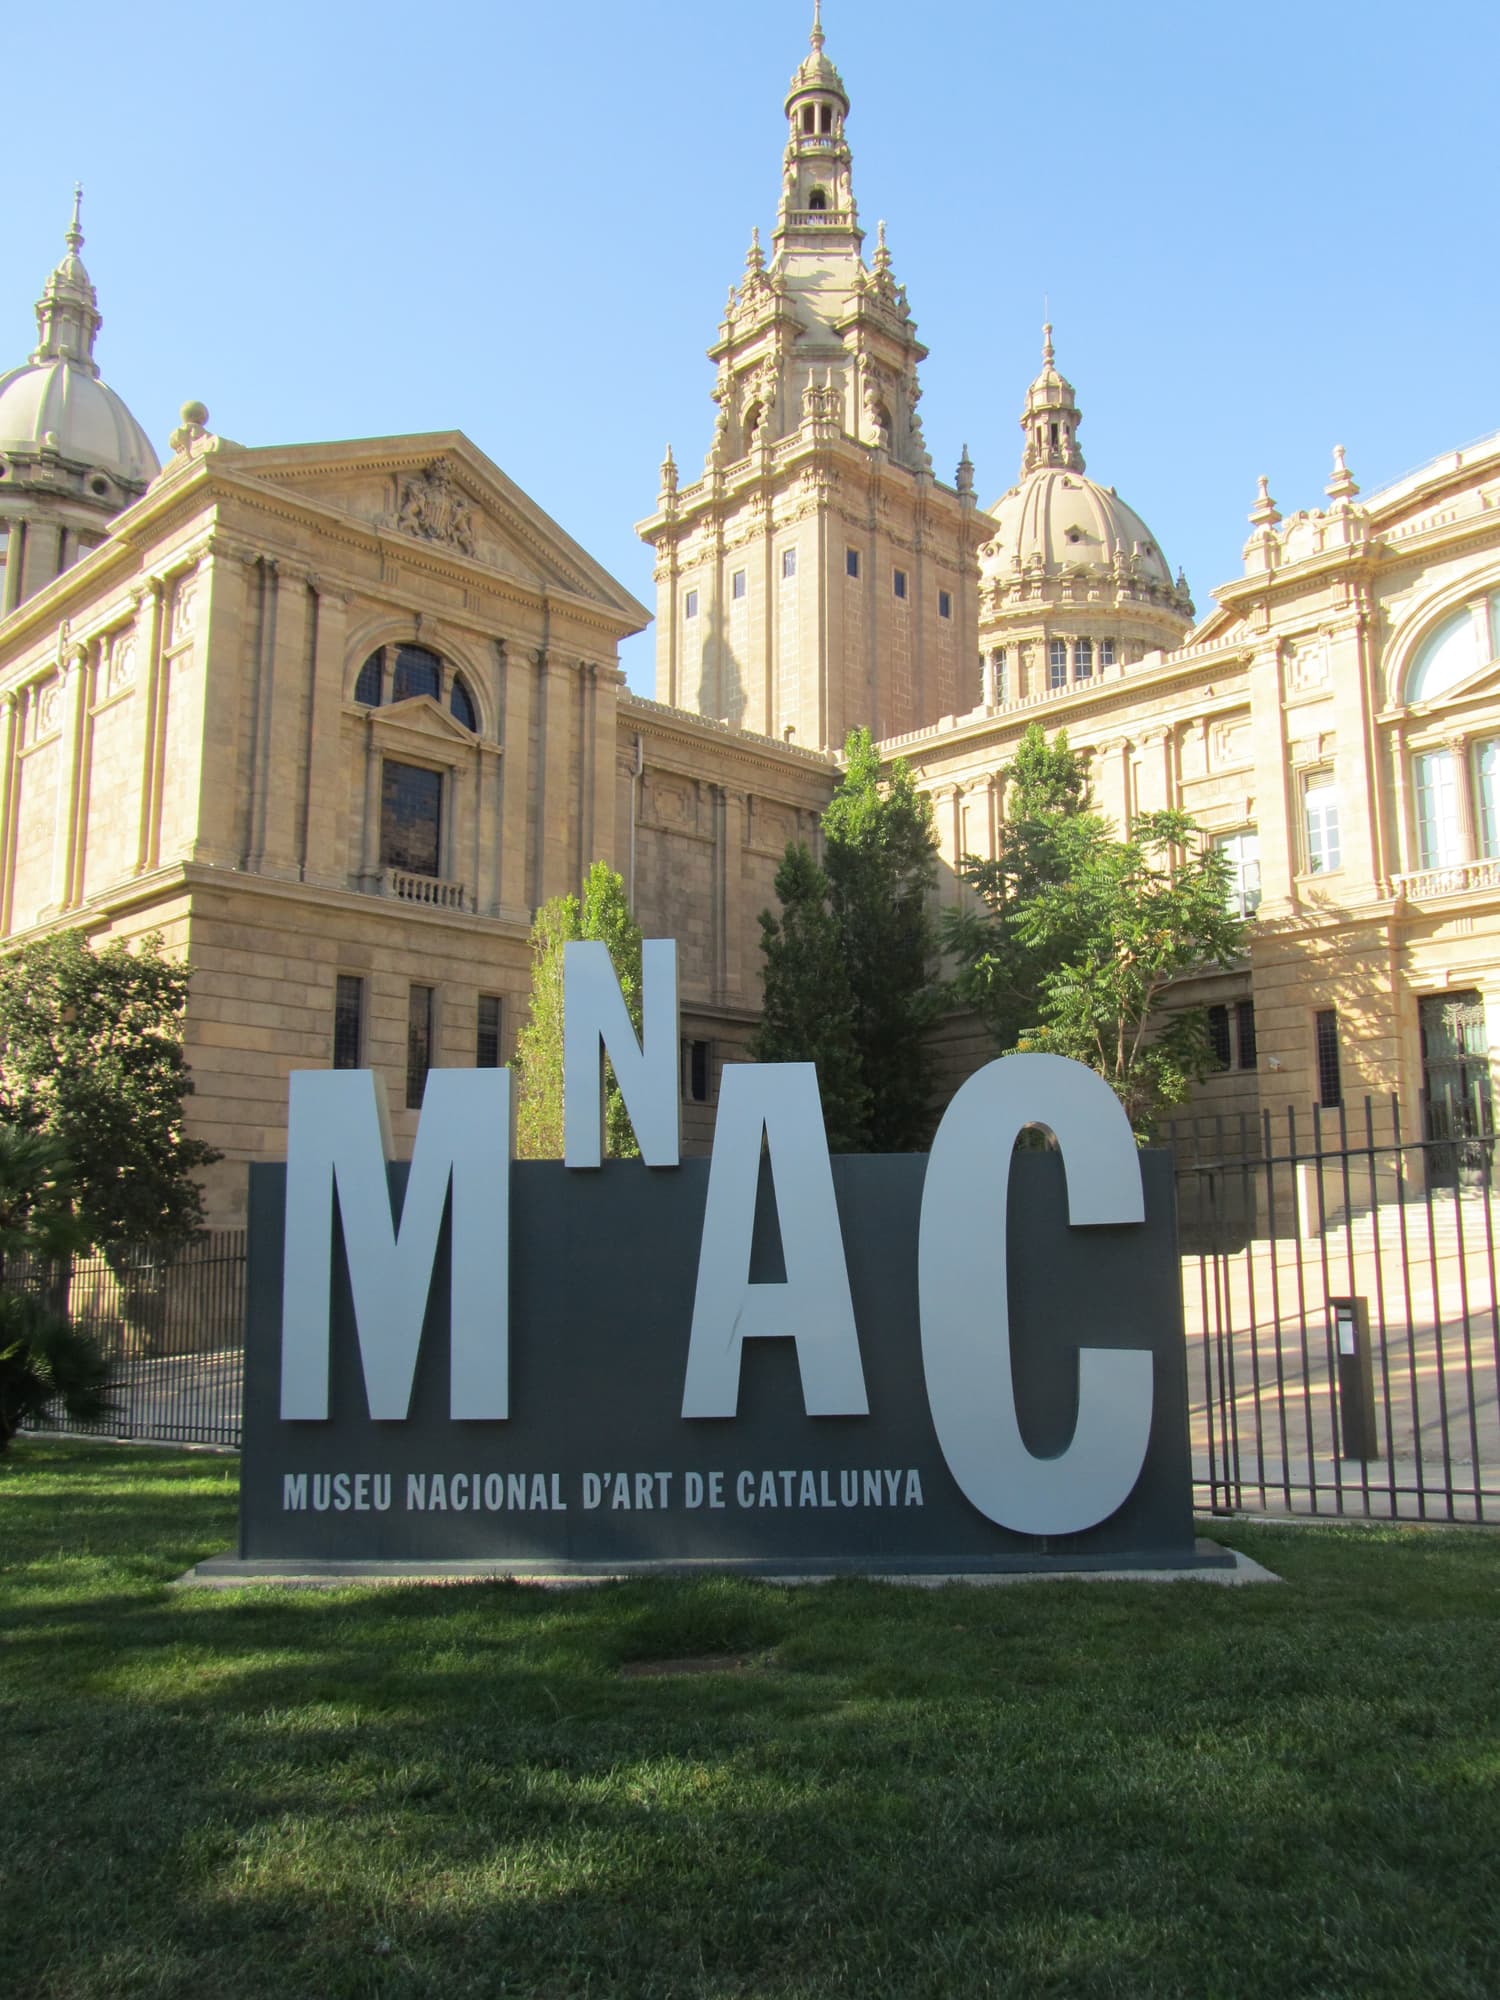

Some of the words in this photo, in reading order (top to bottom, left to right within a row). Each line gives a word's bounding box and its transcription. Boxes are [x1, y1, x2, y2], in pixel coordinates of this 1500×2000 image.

[280, 938, 1155, 1537] MNAC
[282, 1473, 393, 1511] MUSEU
[406, 1473, 568, 1511] NACIONAL
[582, 1472, 673, 1510] D'ART
[685, 1471, 726, 1509] DE
[736, 1469, 924, 1508] CATALUNYA
